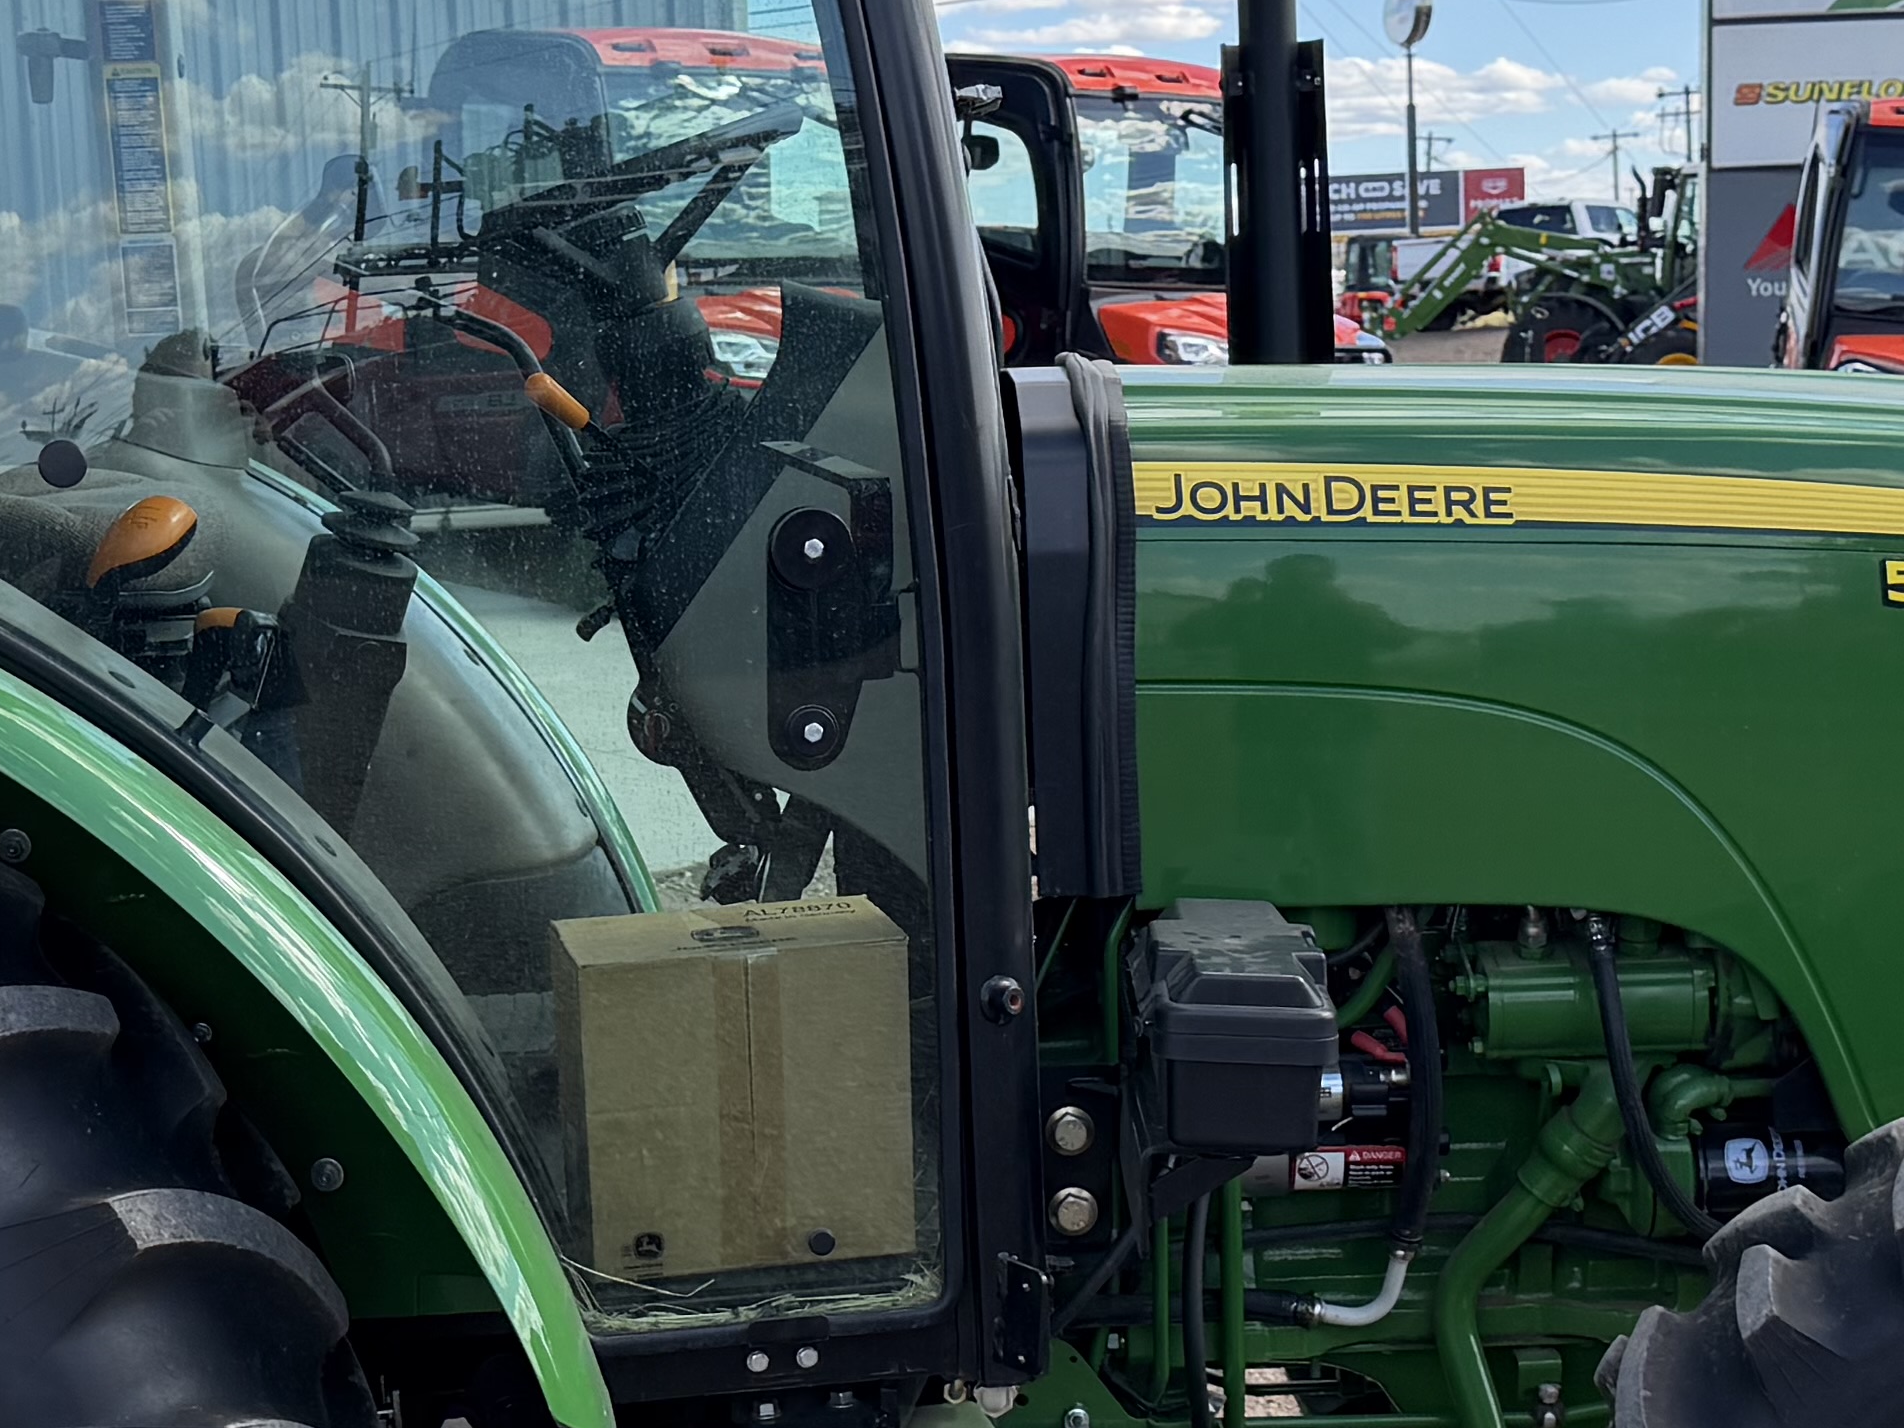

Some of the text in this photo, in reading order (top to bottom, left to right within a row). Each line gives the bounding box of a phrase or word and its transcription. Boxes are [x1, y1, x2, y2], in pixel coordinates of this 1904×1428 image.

[1392, 178, 1441, 197] SVE
[1153, 473, 1515, 520] JOHN DEERE
[1361, 1150, 1402, 1160] DANGER
